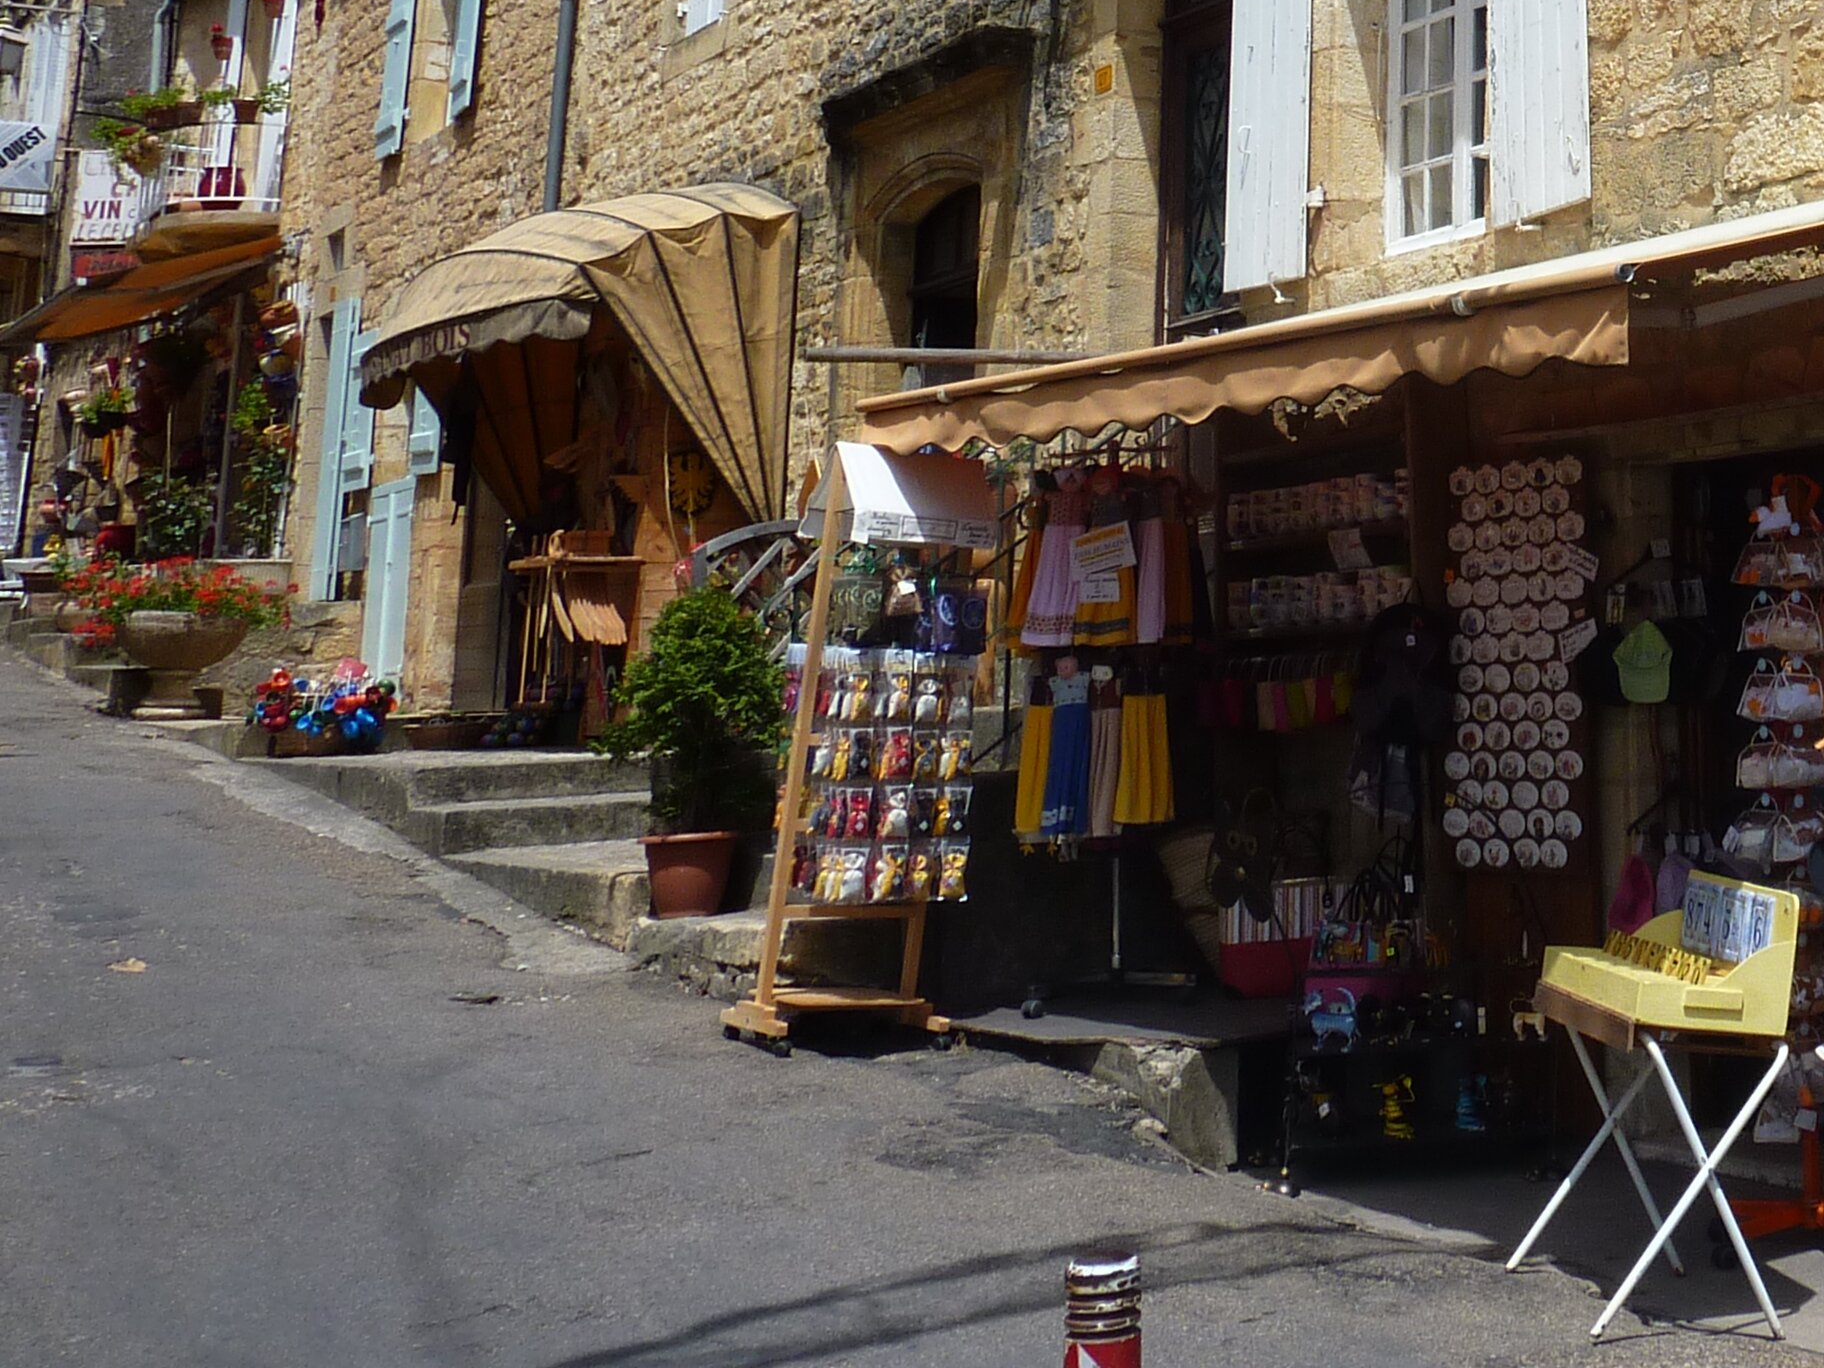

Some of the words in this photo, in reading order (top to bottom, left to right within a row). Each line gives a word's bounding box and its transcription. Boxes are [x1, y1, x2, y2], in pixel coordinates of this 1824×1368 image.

[2, 125, 48, 161] OUEST
[83, 199, 123, 220] VIN
[422, 322, 471, 357] BOIS
